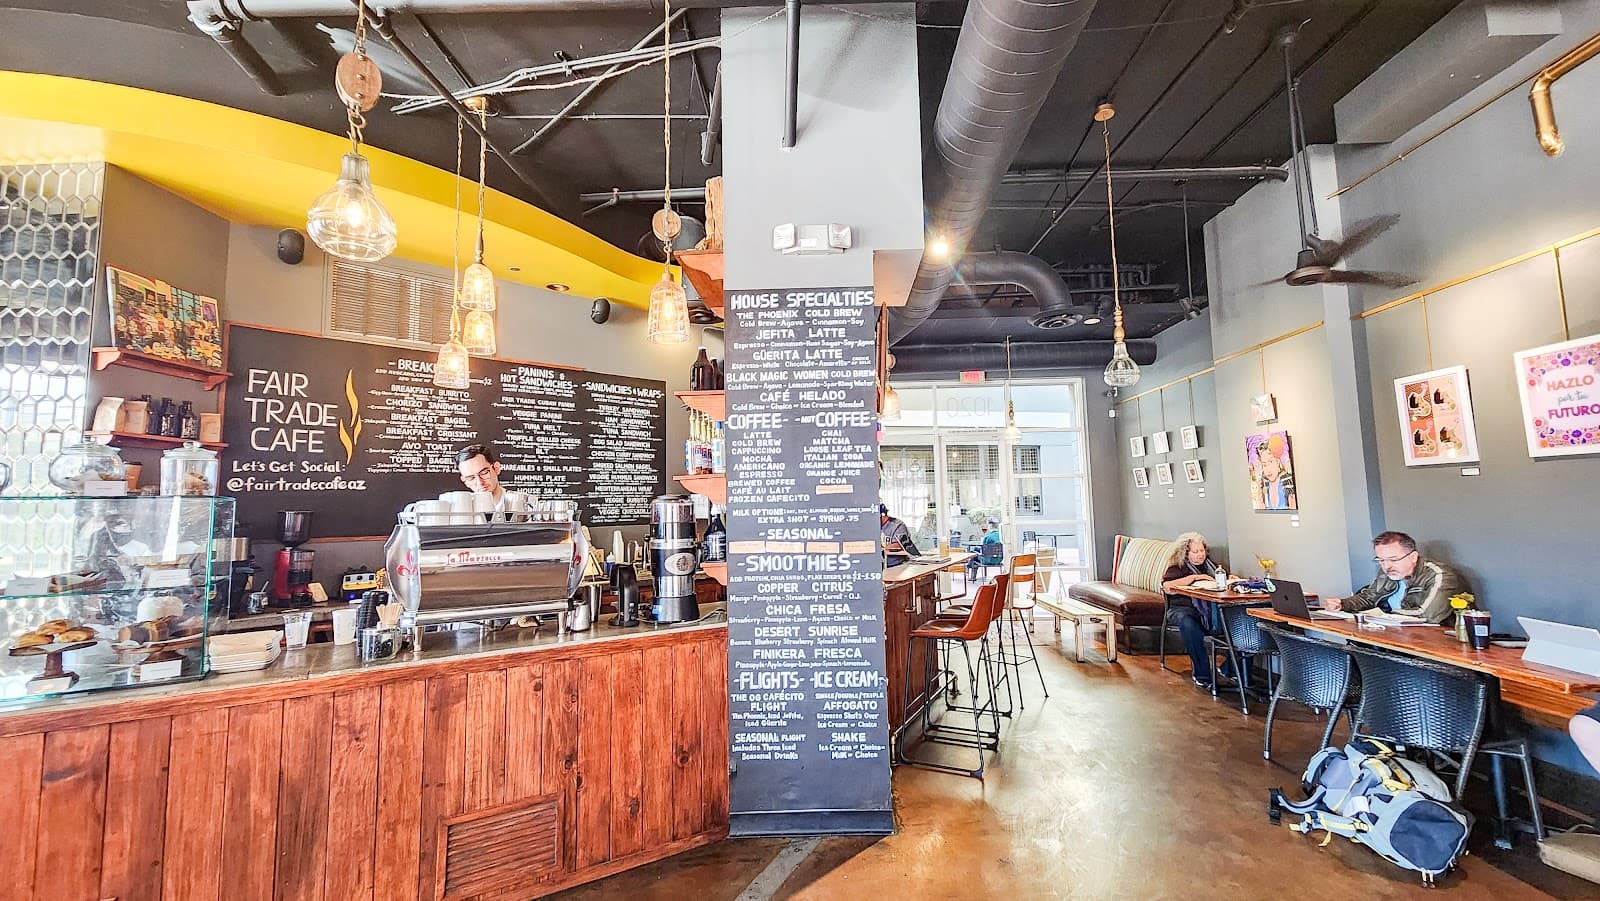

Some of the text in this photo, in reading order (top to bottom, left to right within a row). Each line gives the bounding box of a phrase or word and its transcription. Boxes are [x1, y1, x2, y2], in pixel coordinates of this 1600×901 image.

[731, 291, 874, 310] HOUSE SPECIALTIES
[758, 310, 798, 318] PHOENIX
[806, 309, 830, 318] COLD
[834, 308, 863, 317] BREW
[756, 328, 846, 340] JEFITA LATTE
[753, 349, 842, 361] GÜERITA LATTE
[500, 374, 517, 383] HOT
[727, 372, 757, 382] BLACK
[760, 371, 788, 382] MAGIC
[793, 370, 828, 380] WOMEN
[853, 370, 876, 378] BREW
[248, 368, 308, 398] FAIR
[1546, 375, 1594, 392] HAZLO
[391, 384, 434, 394] BREAKFAST
[438, 390, 470, 398] BURRITO
[760, 389, 846, 402] CAFÉ HELADO
[386, 398, 422, 407] CHORIZO
[428, 402, 468, 412] SANDWICH
[244, 398, 338, 426] TRADE
[540, 412, 562, 420] PANINI
[1548, 404, 1600, 420] FUTURO
[391, 413, 438, 423] BREAKFAST
[386, 427, 434, 436] BREAKFAST
[438, 430, 478, 438] CROISSANT
[543, 424, 562, 432] MELT
[251, 428, 325, 452] CAFE
[813, 437, 850, 445] MATCHA
[742, 455, 772, 463] MOCHA
[232, 460, 346, 473] Let's Get Social:
[733, 463, 786, 471] AMERICANO
[226, 476, 366, 492] @fairtradecafeaz
[728, 494, 810, 503] FROZEN CAFECITO
[758, 582, 854, 594] COPPER CITRUS
[766, 604, 851, 615] CHICA FRESA
[754, 626, 858, 637] DESERT SUNRISE
[753, 648, 862, 660] FINIKERA FRESCA
[731, 694, 747, 702] THE
[751, 702, 788, 712] FLIGHT
[824, 700, 878, 710] AFFOGATO
[735, 732, 779, 743] SEASONAL
[832, 733, 866, 742] SHAKE
